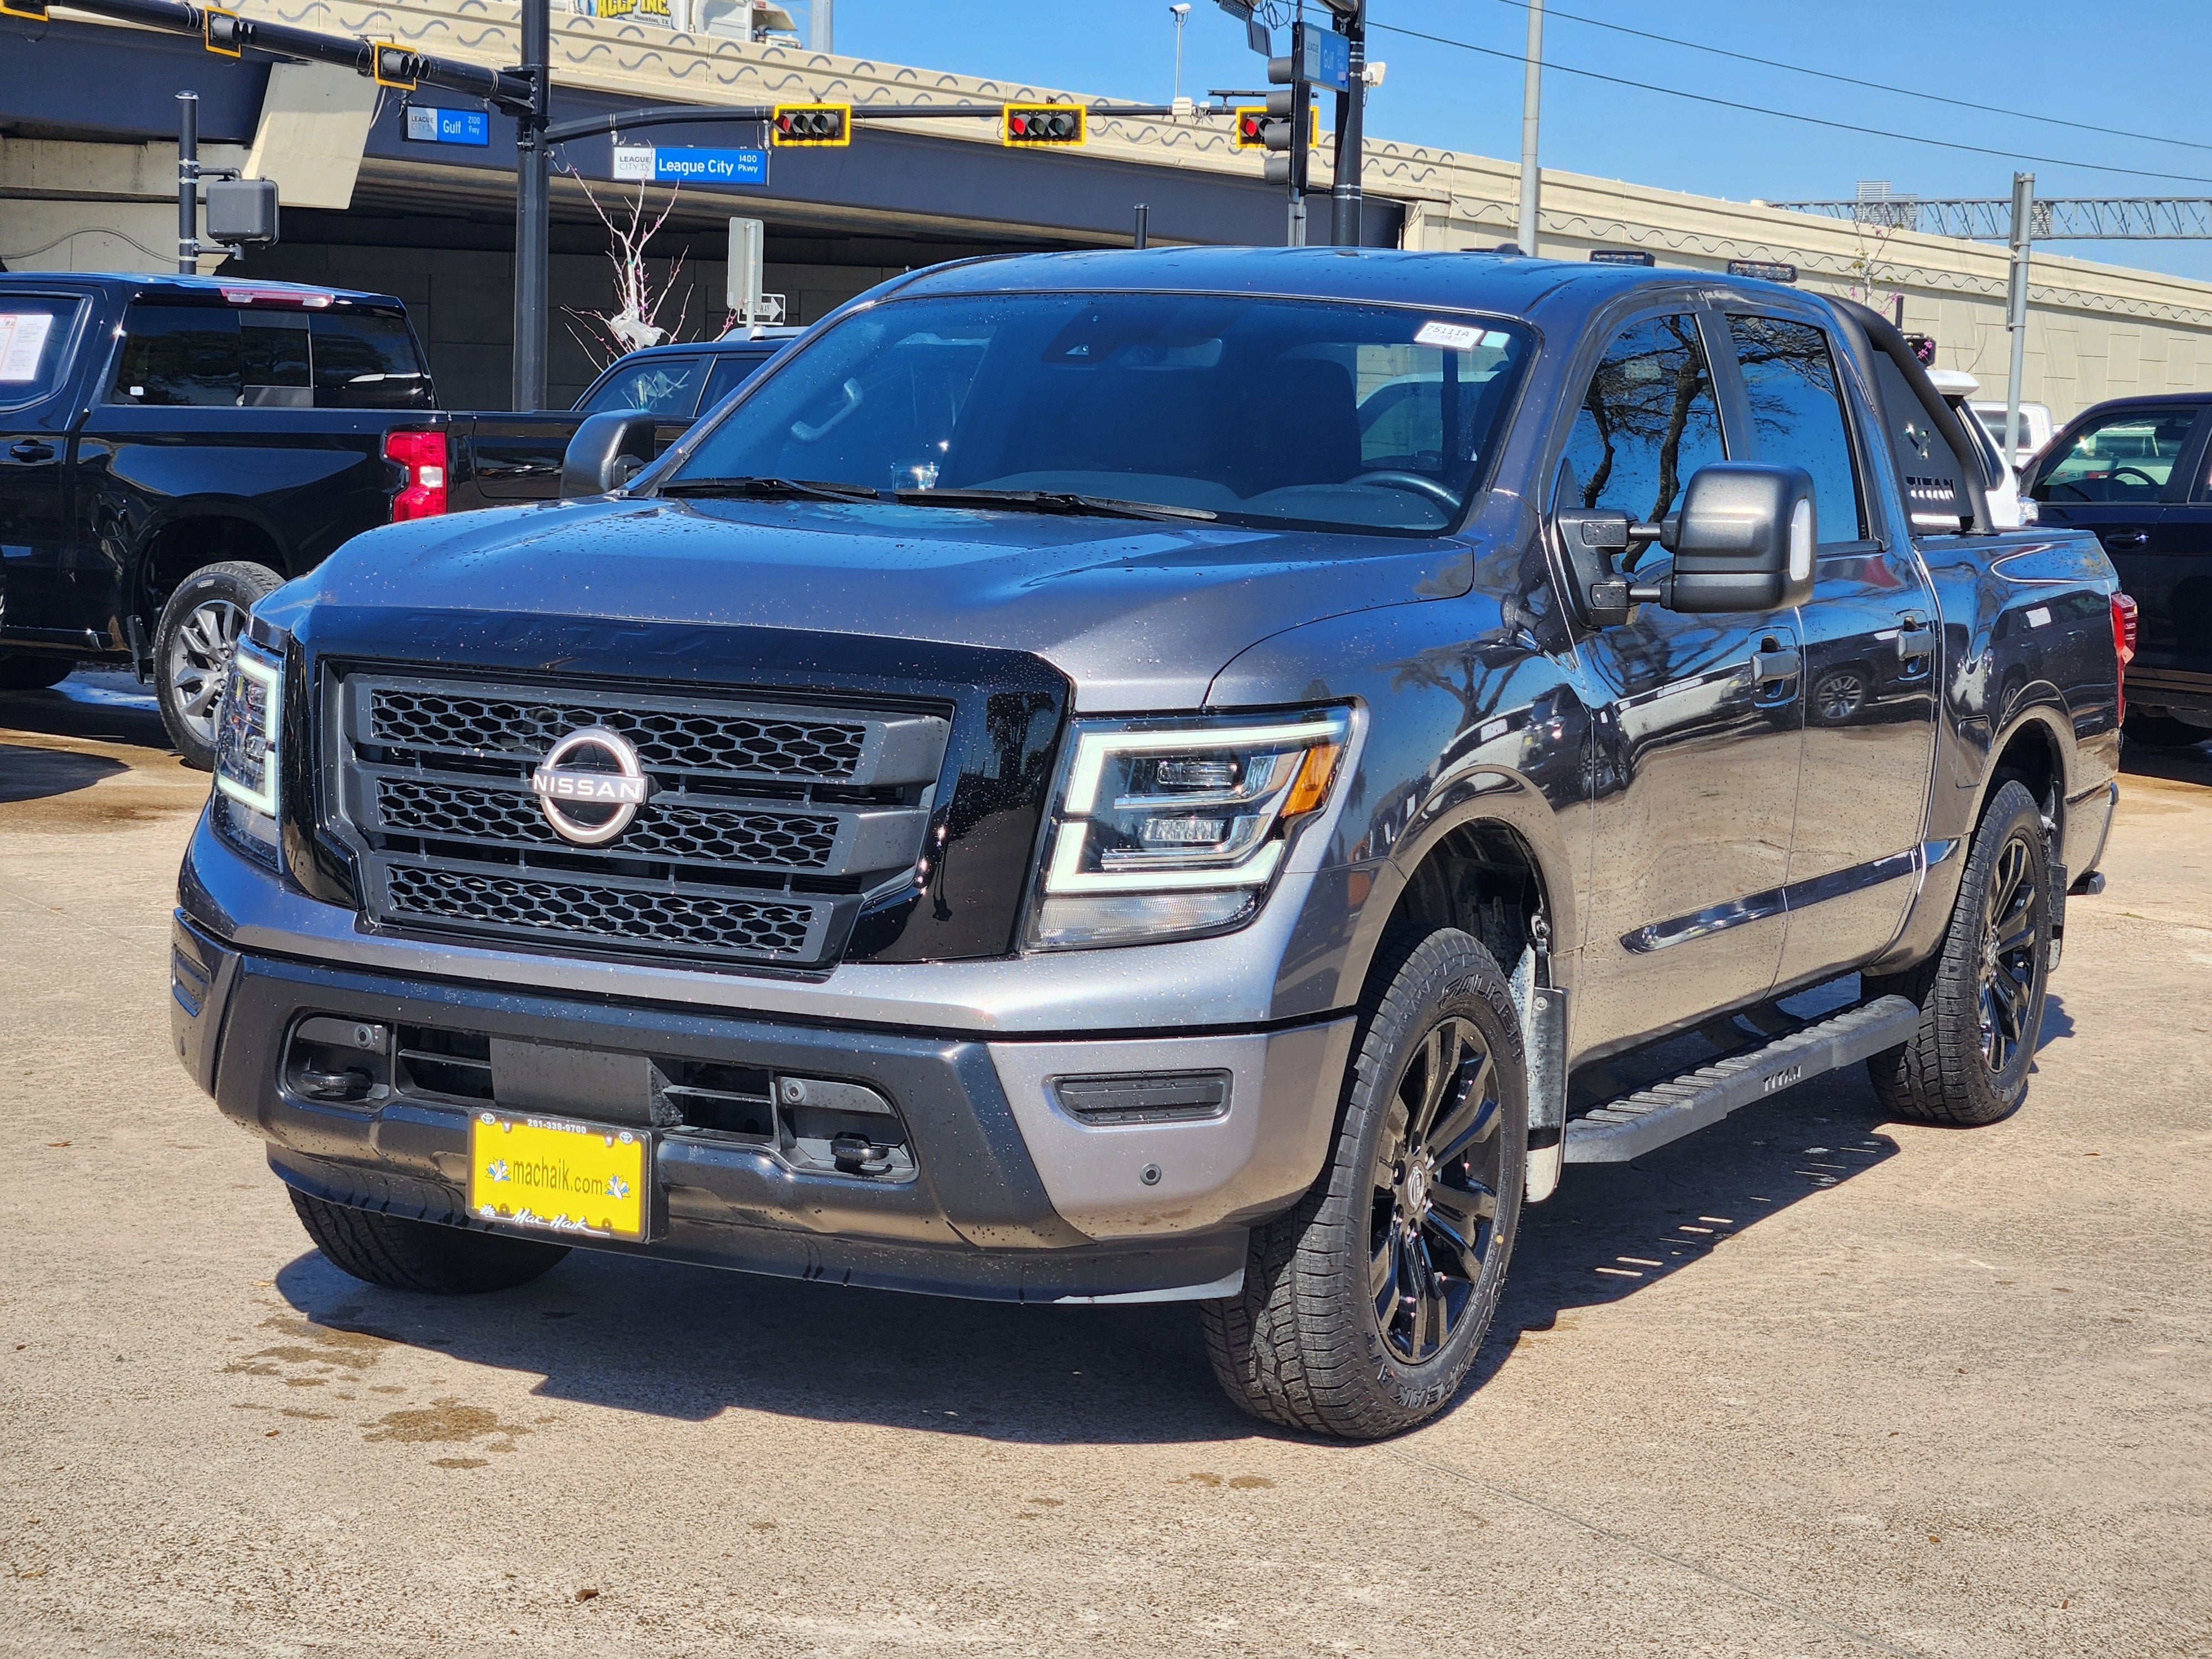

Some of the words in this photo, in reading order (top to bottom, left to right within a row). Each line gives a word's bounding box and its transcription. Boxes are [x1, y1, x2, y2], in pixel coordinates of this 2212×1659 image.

[443, 119, 461, 134] Gulf
[468, 125, 480, 135] Fwy
[659, 158, 705, 176] League
[707, 159, 734, 176] City
[739, 155, 757, 163] 1400
[738, 164, 758, 174] Pkwy
[1426, 325, 1470, 337] 75111A
[1906, 476, 1957, 502] TITAN
[533, 774, 640, 799] NISSAN
[1762, 1063, 1802, 1092] TITAN
[513, 1156, 603, 1196] machaik.com
[512, 1207, 548, 1225] Mac
[550, 1213, 587, 1230] Haik
